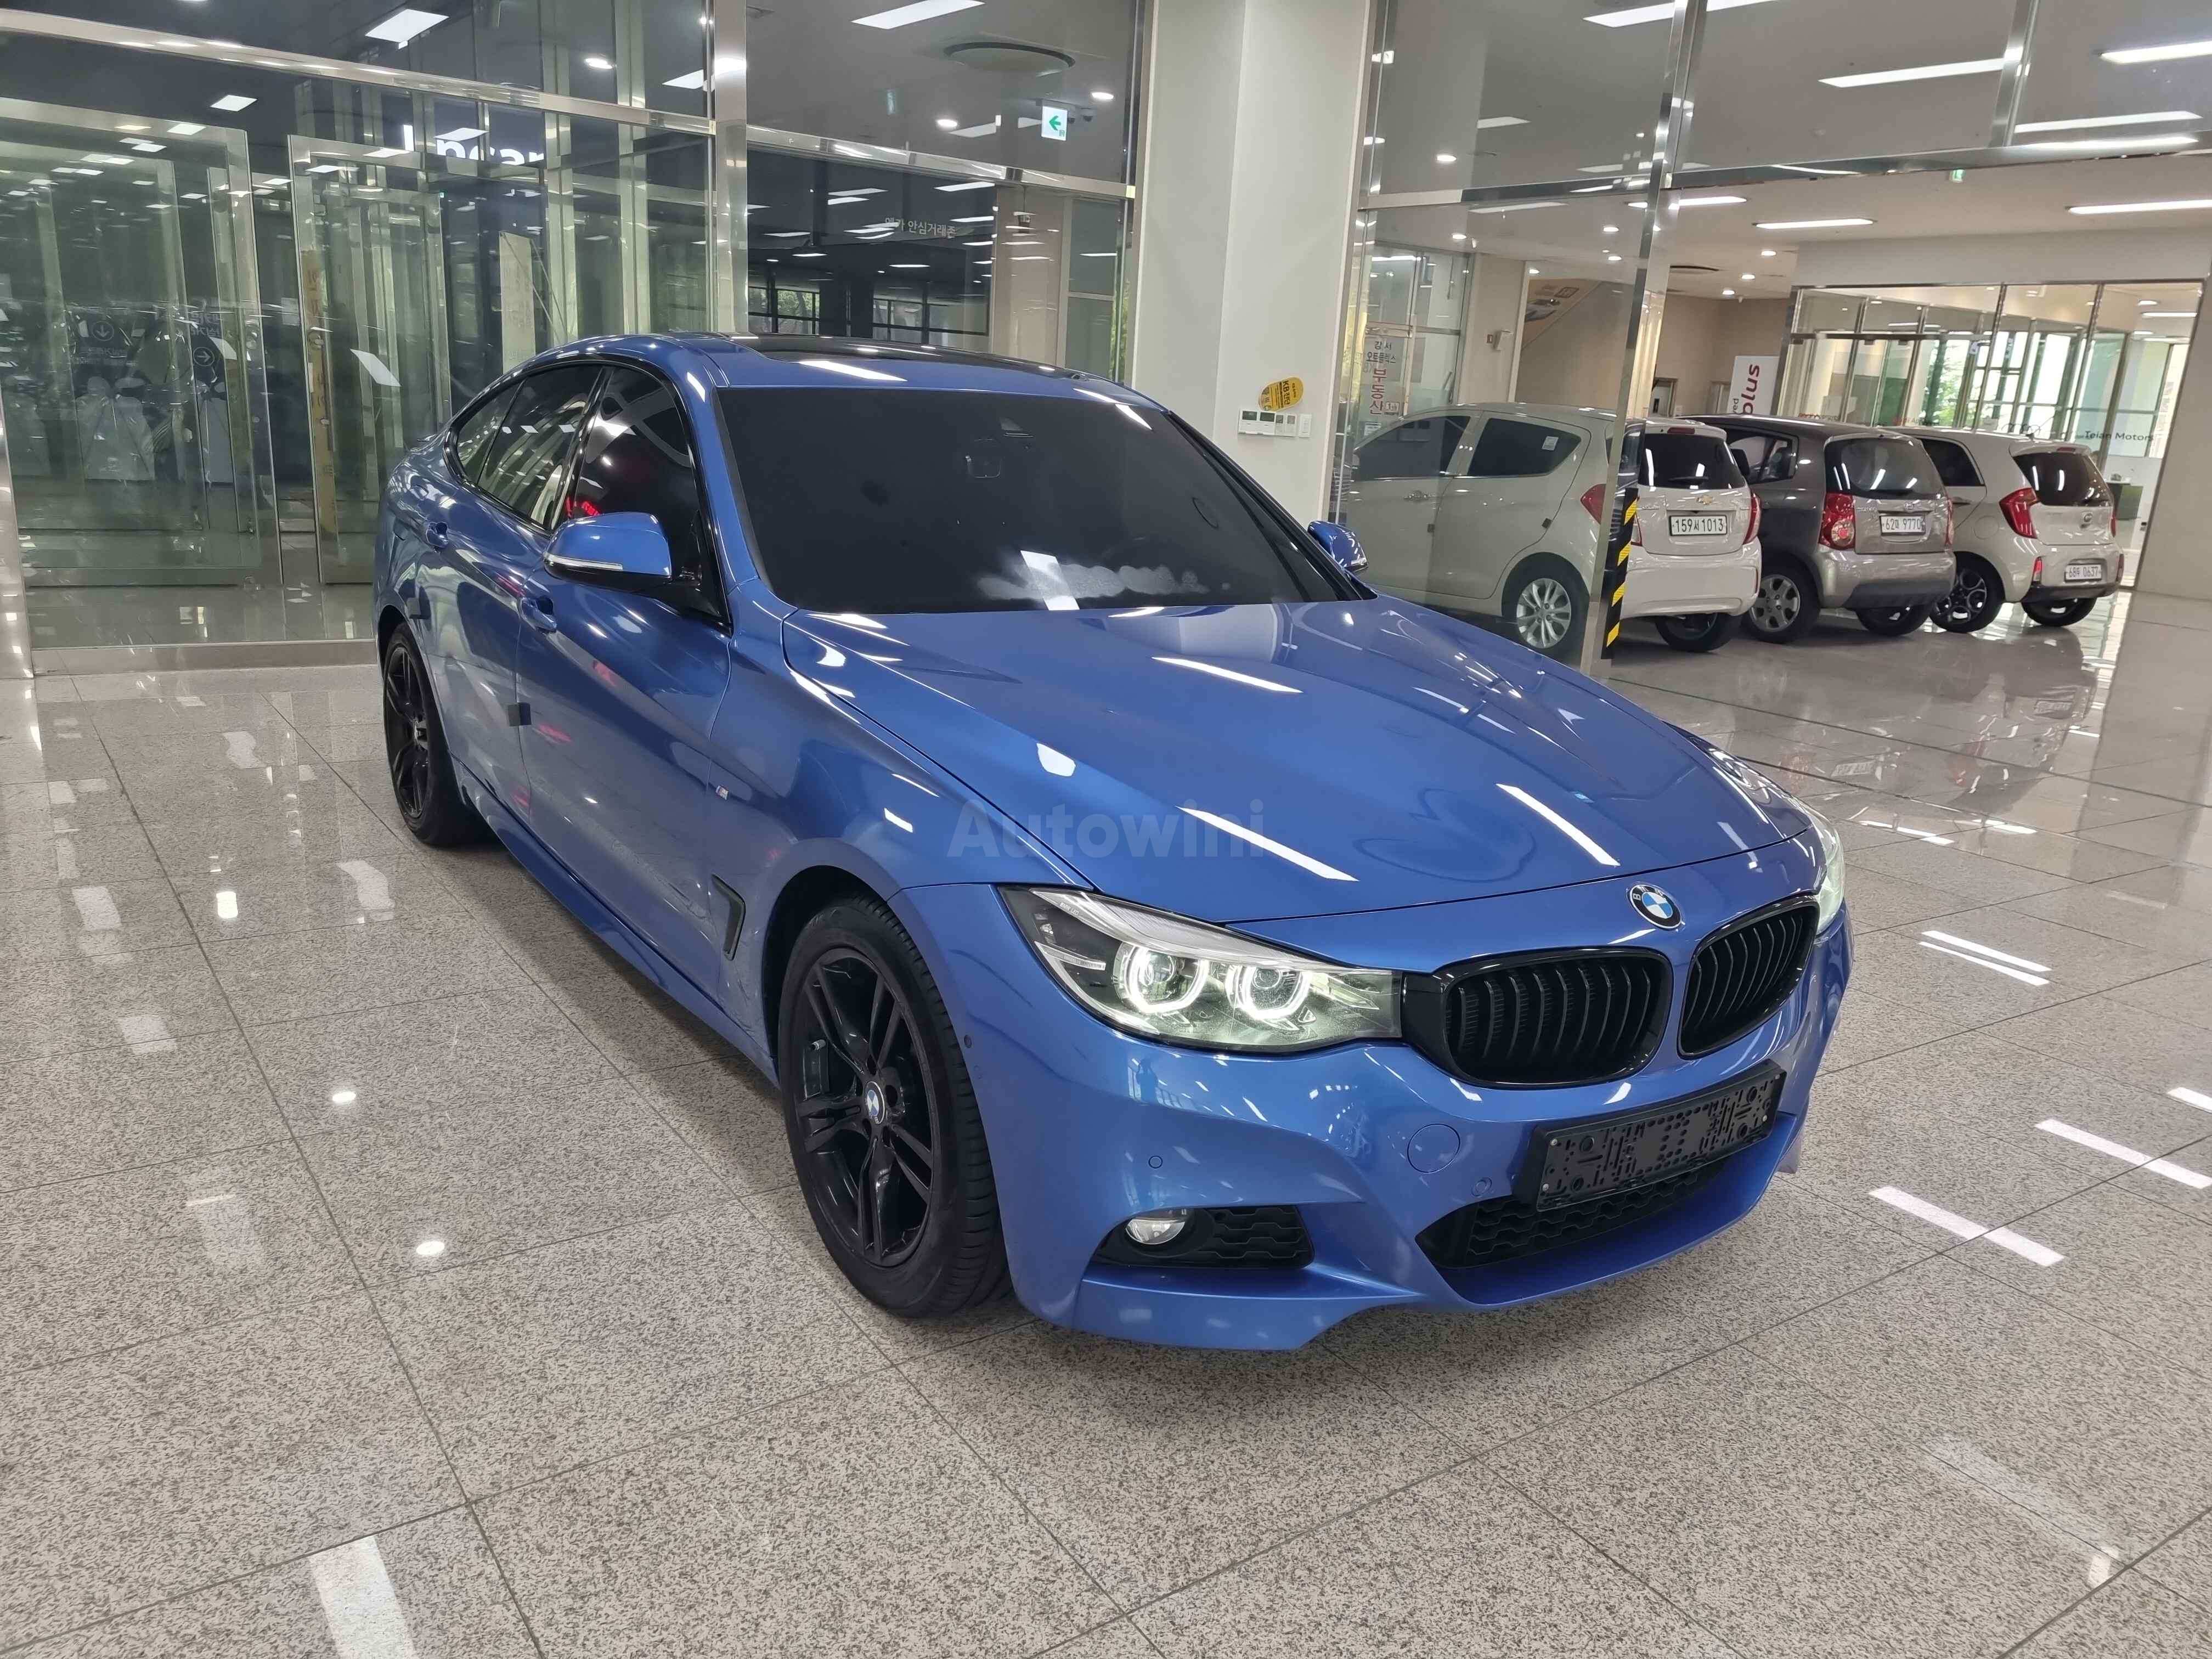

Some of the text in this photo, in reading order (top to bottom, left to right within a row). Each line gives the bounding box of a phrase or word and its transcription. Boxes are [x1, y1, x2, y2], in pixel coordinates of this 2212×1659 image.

[908, 221, 957, 239] 안심거래존
[1369, 368, 1387, 415] 부동산
[2115, 432, 2154, 442] Motors
